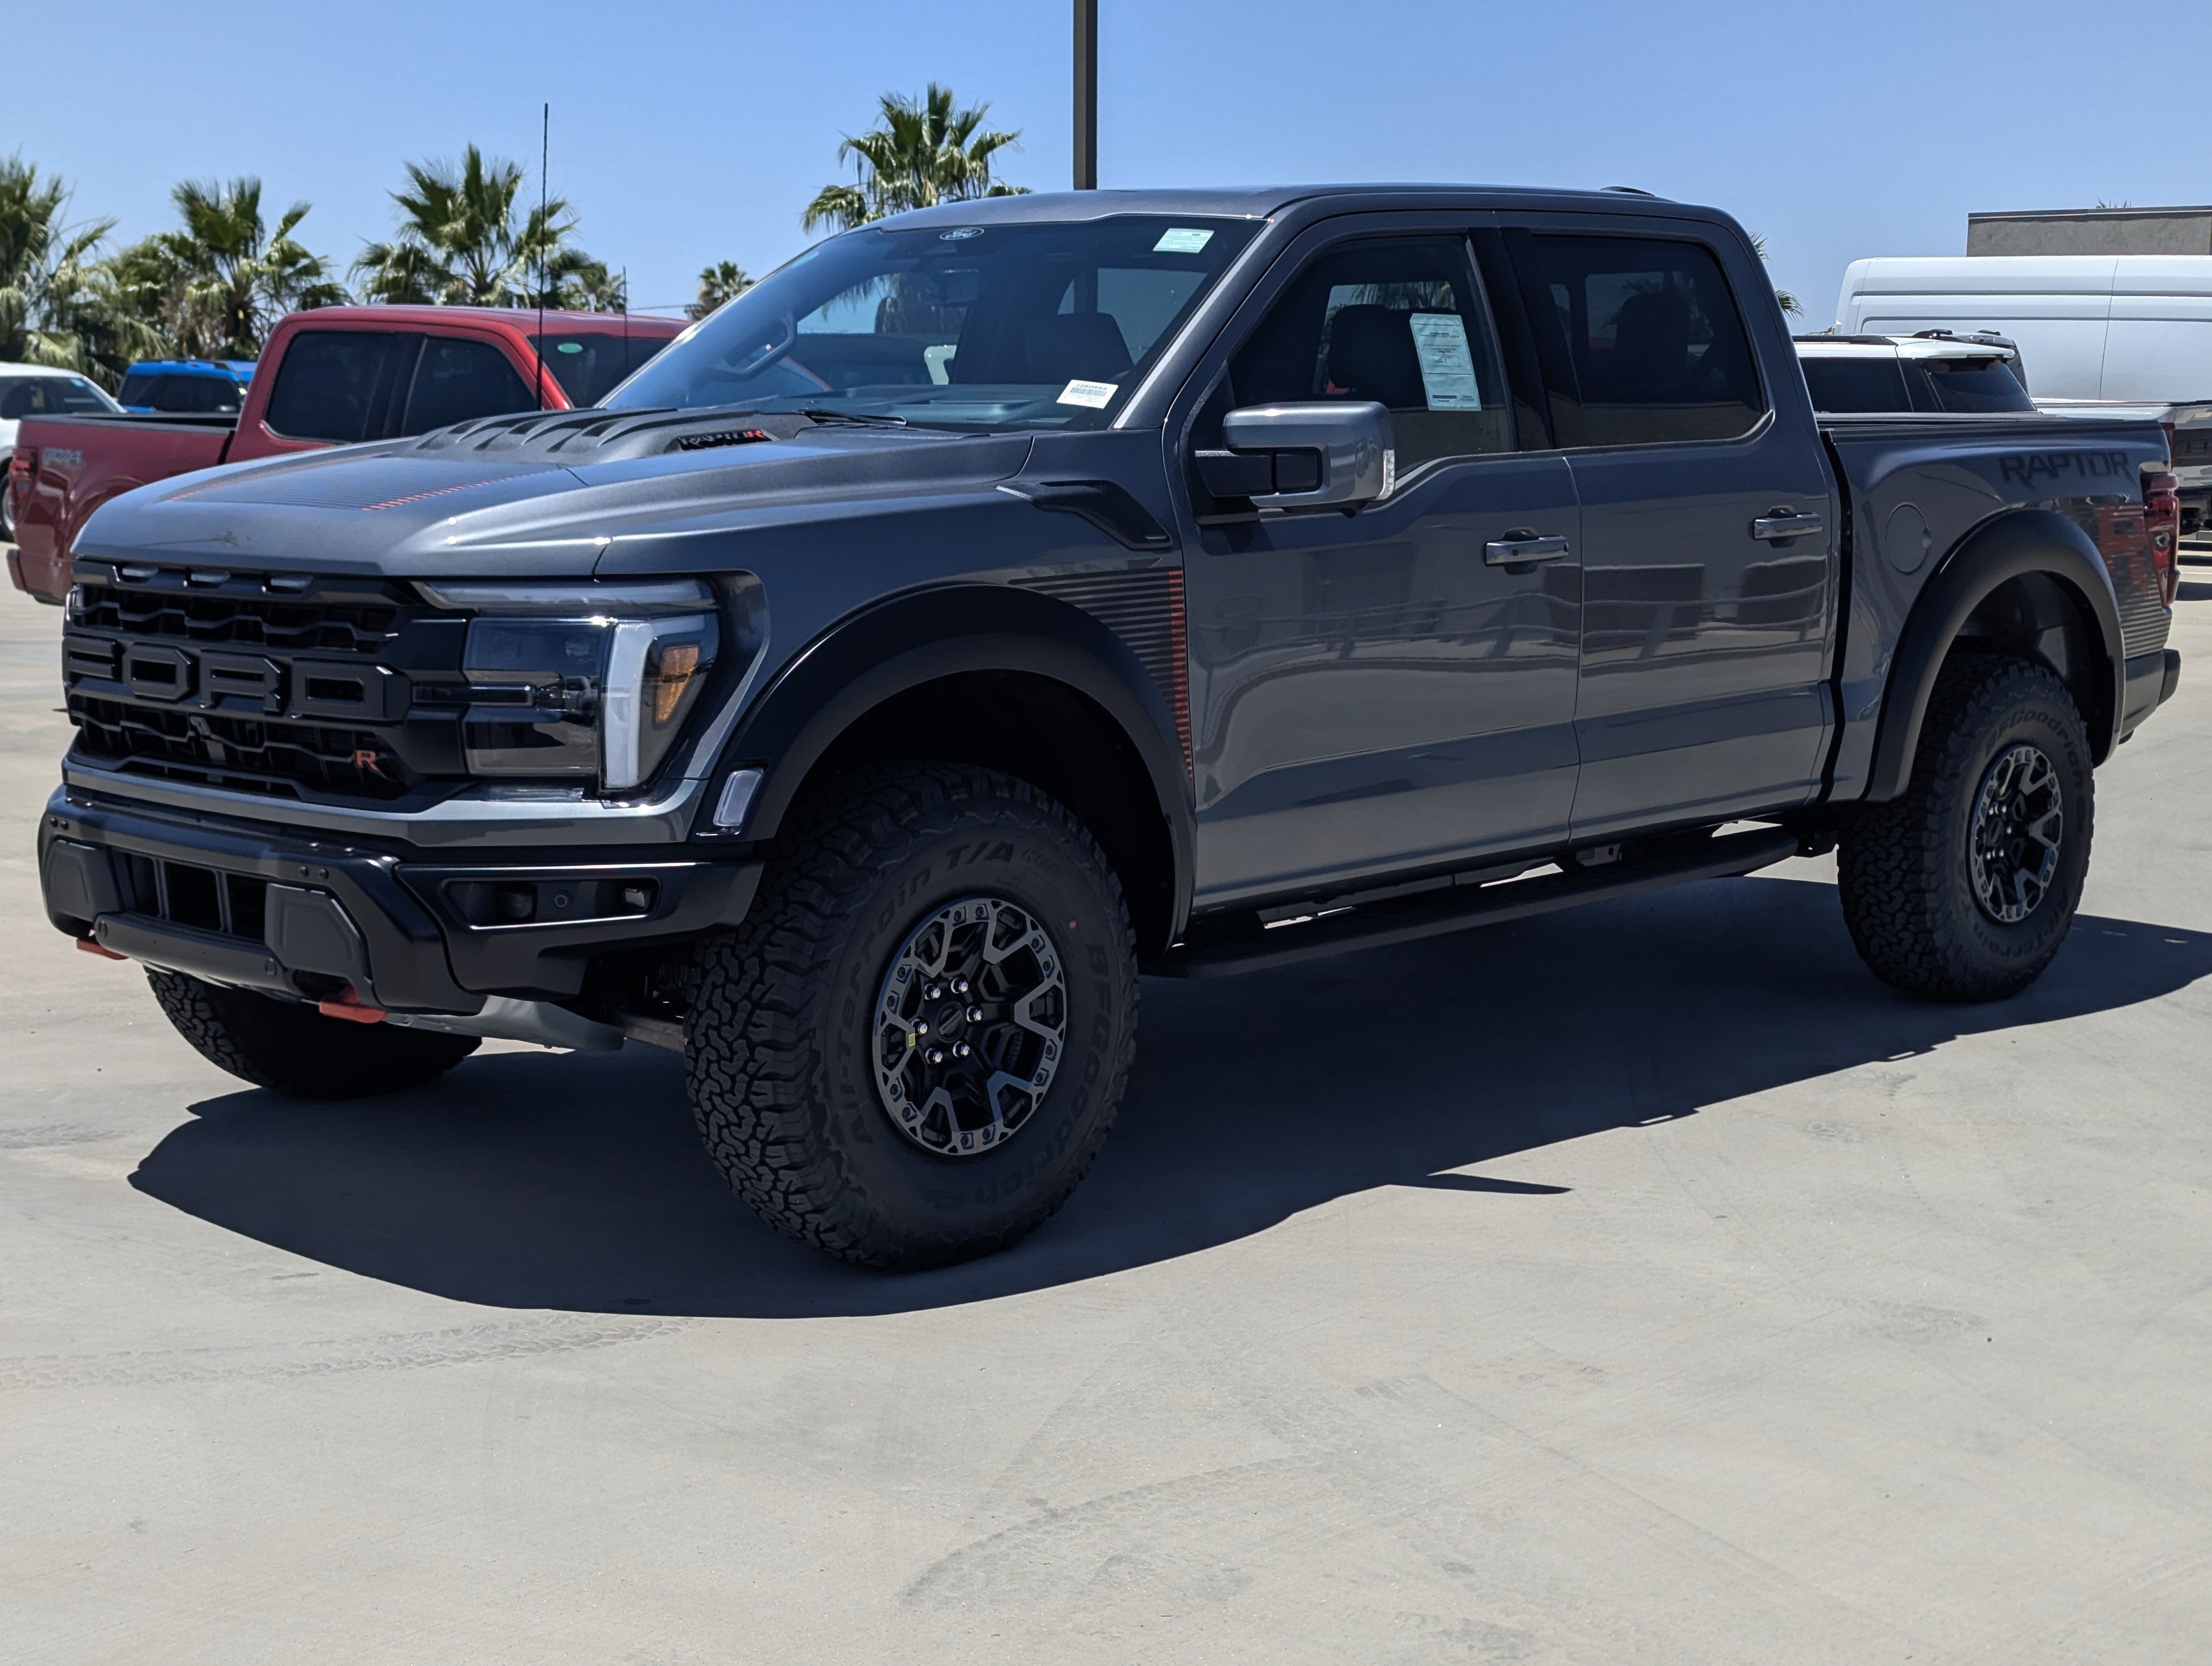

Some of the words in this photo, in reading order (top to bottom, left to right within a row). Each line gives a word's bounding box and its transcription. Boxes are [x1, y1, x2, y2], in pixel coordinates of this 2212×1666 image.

[1998, 451, 2138, 490] RAPTOR
[62, 635, 412, 722] FORD
[356, 751, 389, 780] R
[946, 841, 1015, 870] T/A
